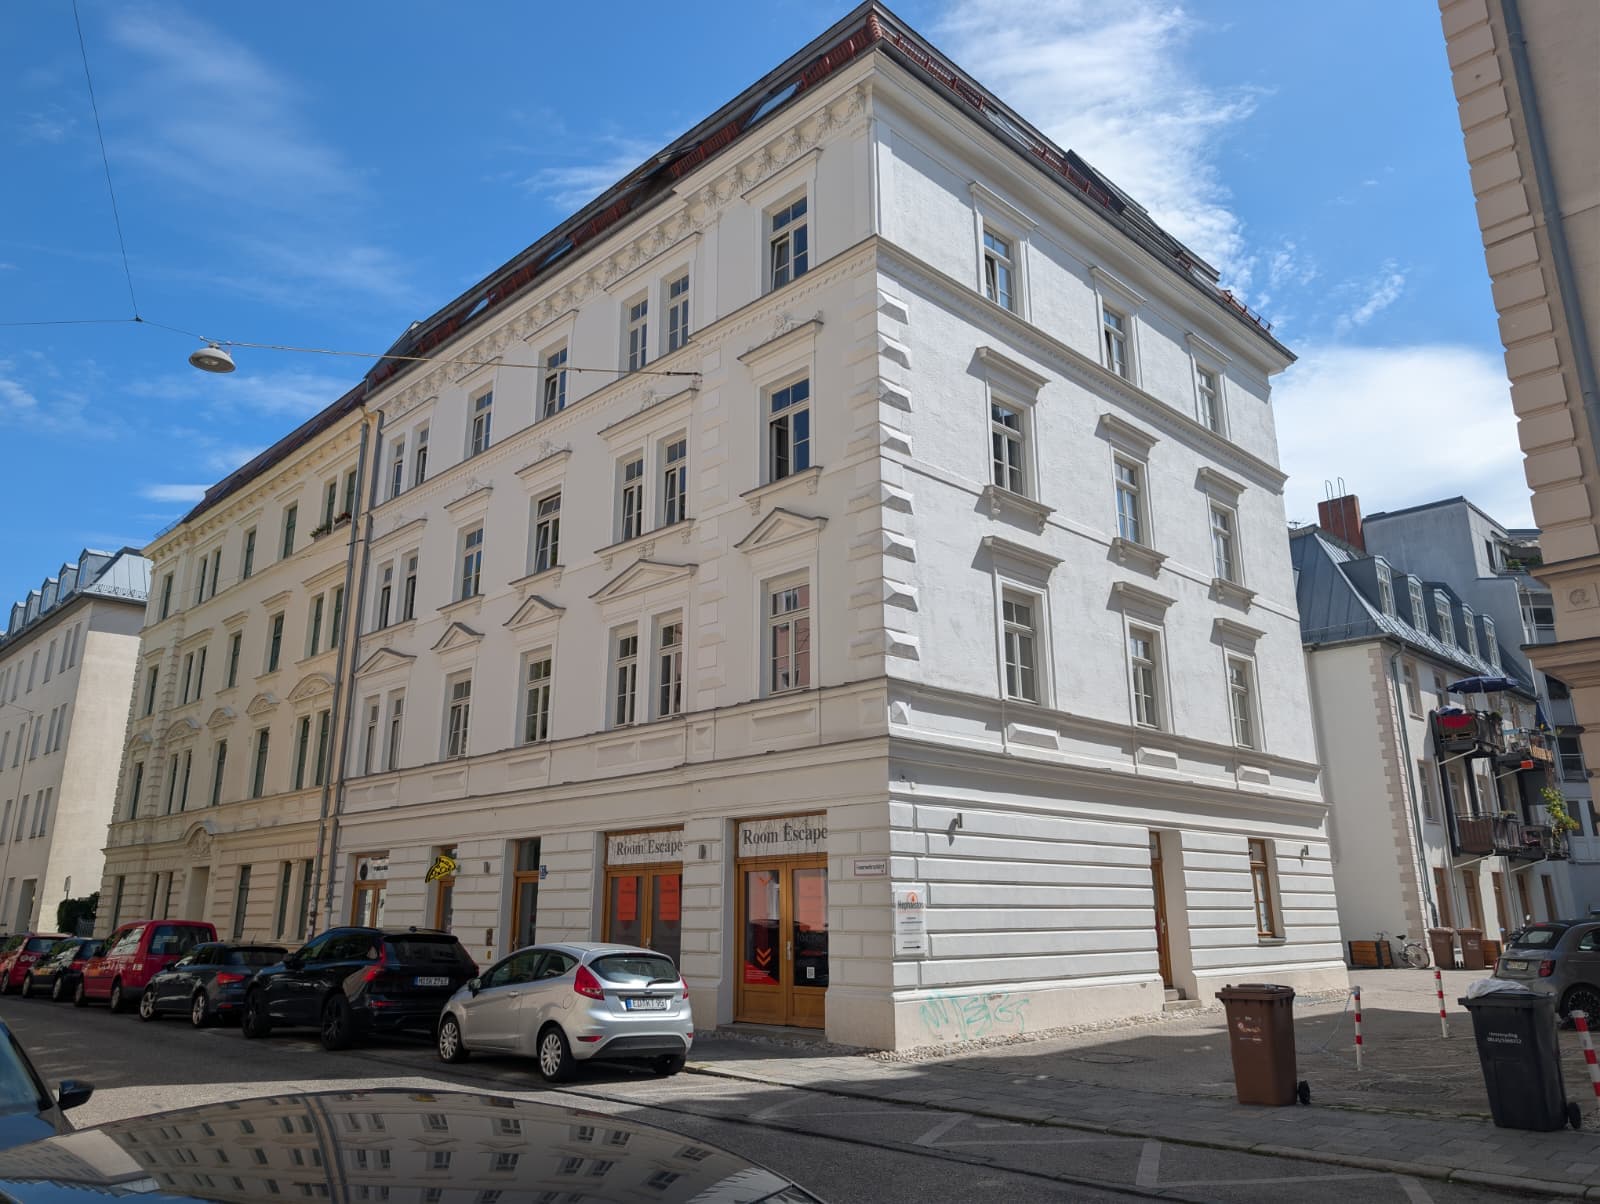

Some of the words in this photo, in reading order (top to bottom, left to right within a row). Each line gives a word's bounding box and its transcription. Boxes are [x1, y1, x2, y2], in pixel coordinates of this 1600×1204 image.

[743, 829, 778, 845] Room
[784, 822, 829, 844] Escape
[616, 841, 644, 856] Room
[648, 839, 683, 857] Escape
